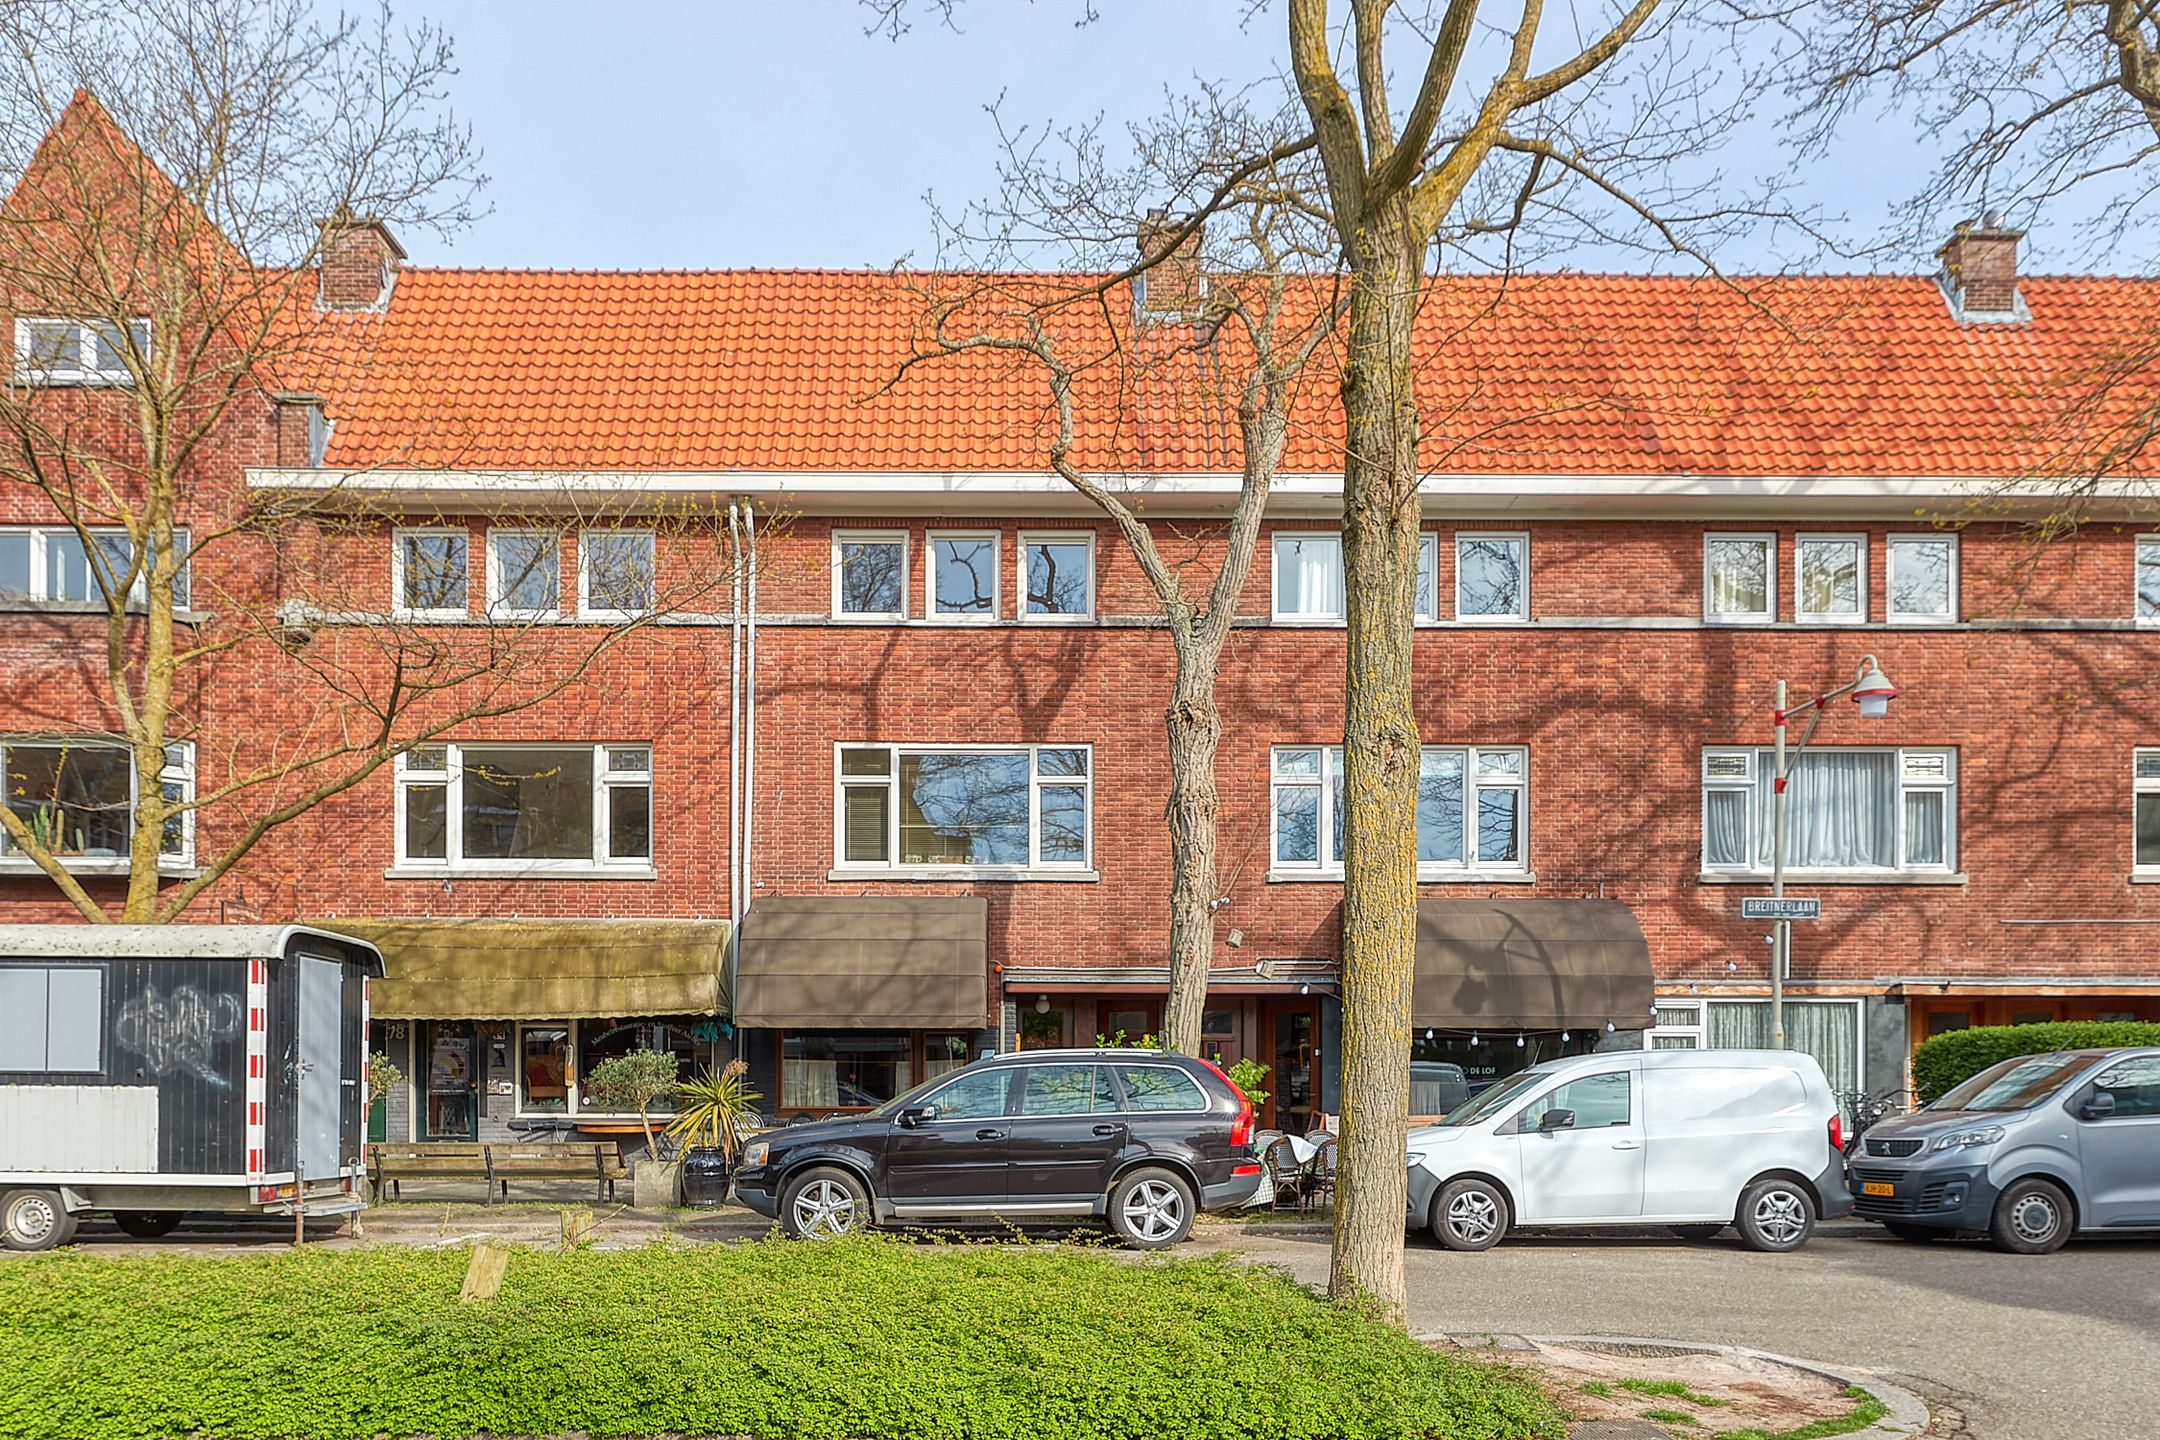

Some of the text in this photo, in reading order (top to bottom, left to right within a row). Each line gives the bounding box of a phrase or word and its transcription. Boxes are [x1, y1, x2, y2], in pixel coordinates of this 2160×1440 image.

[1748, 901, 1816, 912] BREITNERLAAN
[1470, 1066, 1480, 1075] DE
[1482, 1066, 1496, 1075] LOF
